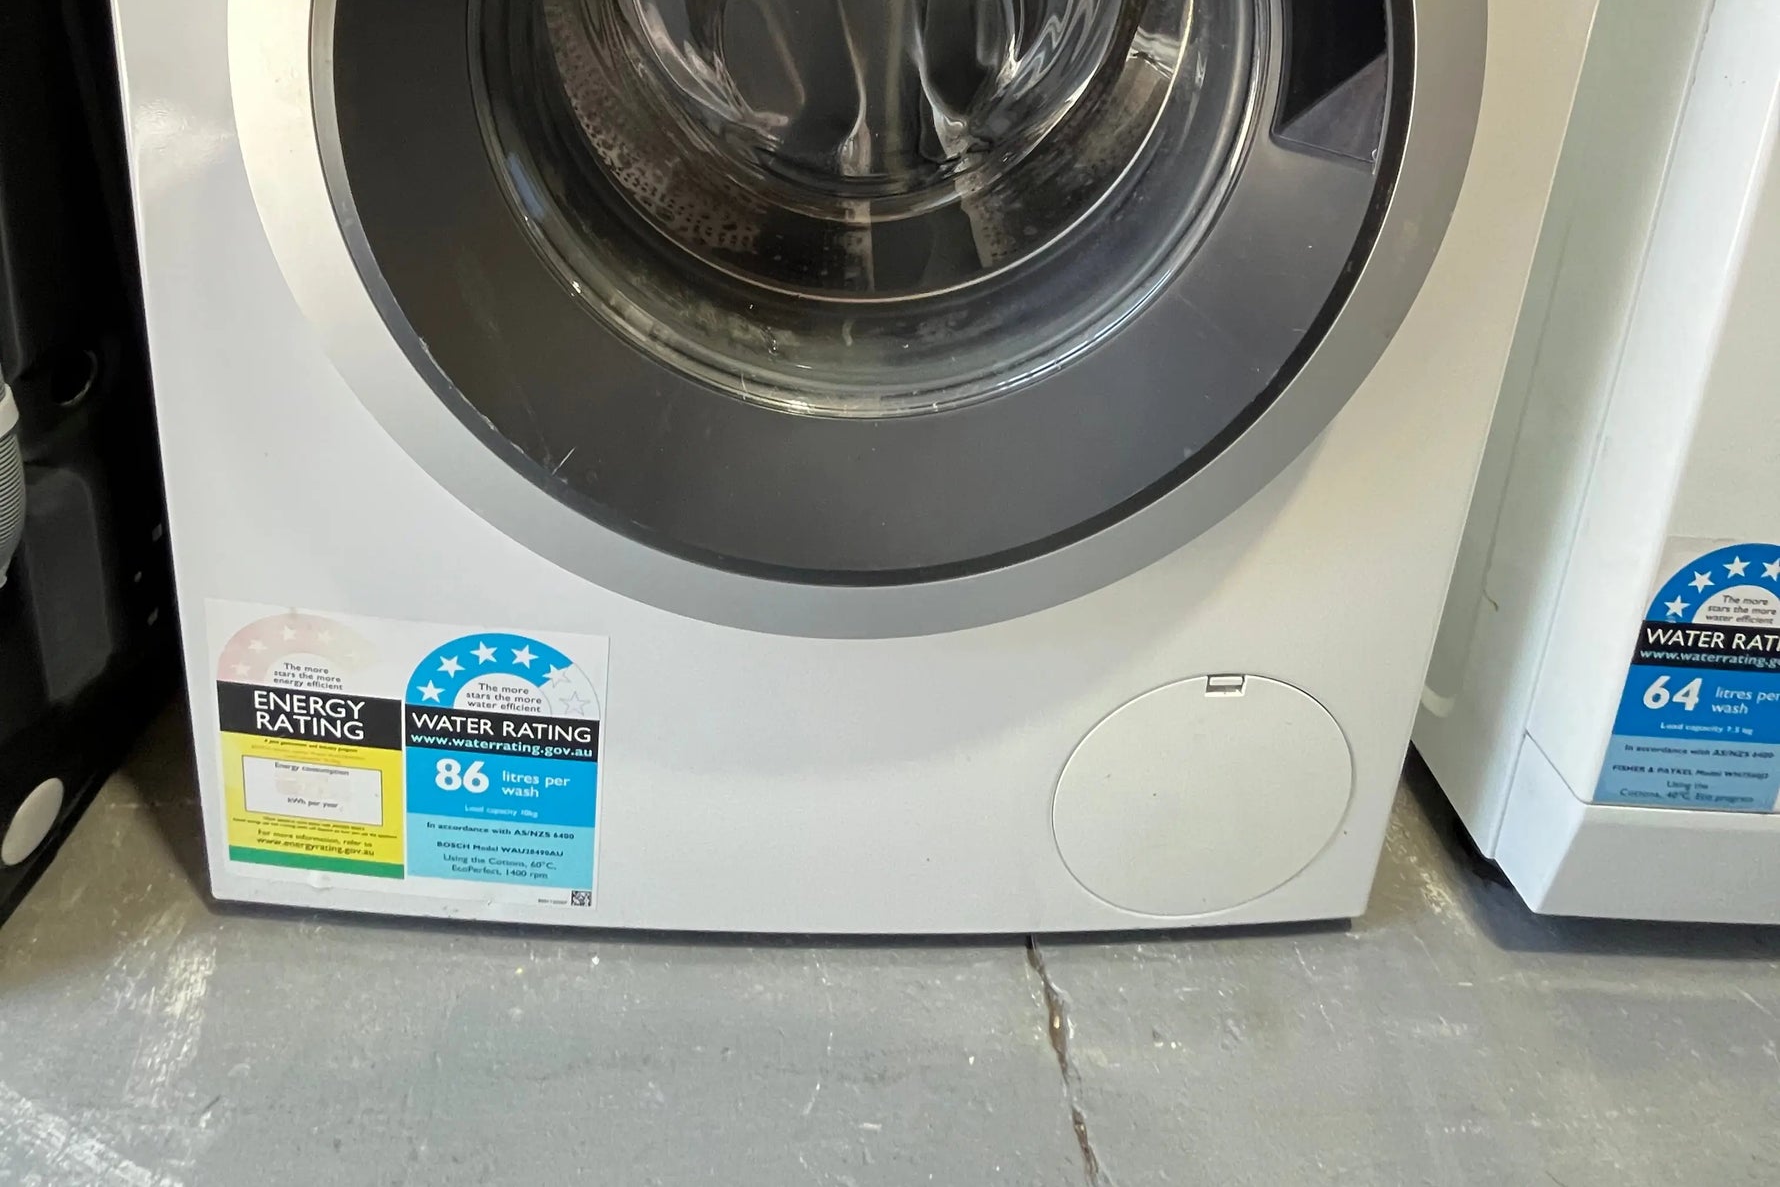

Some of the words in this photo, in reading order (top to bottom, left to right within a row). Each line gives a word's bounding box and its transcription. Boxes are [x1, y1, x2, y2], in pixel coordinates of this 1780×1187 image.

[1723, 595, 1741, 604] The
[1742, 597, 1769, 606] more
[1708, 604, 1730, 613] stars
[1733, 605, 1749, 613] the
[1752, 607, 1777, 615] more
[1736, 614, 1774, 624] efficient
[1646, 627, 1725, 649] WATER
[284, 662, 301, 672] The
[304, 666, 329, 675] more
[274, 670, 295, 679] stars
[298, 672, 313, 680] the
[317, 674, 341, 683] more
[273, 677, 304, 687] energy
[306, 680, 343, 690] efficient
[479, 682, 498, 692] The
[501, 686, 529, 695] more
[466, 692, 491, 700] stars
[494, 693, 511, 702] the
[514, 696, 542, 704] more
[1643, 675, 1703, 711] 64
[1715, 686, 1753, 700] litres
[1756, 692, 1780, 704] per
[254, 690, 365, 719] ENERGY
[467, 700, 498, 709] water
[501, 702, 541, 713] efficient
[1712, 703, 1748, 714] wash
[256, 711, 365, 740] RATING
[412, 713, 494, 736] WATER
[502, 721, 591, 743] RATING
[410, 733, 593, 757] www.waterrating.gov.au
[435, 758, 490, 794] 86
[502, 770, 540, 785] litres
[545, 774, 571, 788] per
[502, 786, 539, 798] wash
[438, 823, 489, 833] accordance
[492, 827, 511, 835] with
[514, 829, 551, 838] AS/NZS
[257, 837, 375, 857] www.energyrating.gov.au
[437, 841, 470, 850] BOSCH
[473, 844, 498, 852] Model
[443, 854, 468, 864] Using
[471, 855, 485, 863] the
[505, 868, 526, 877] 1400
